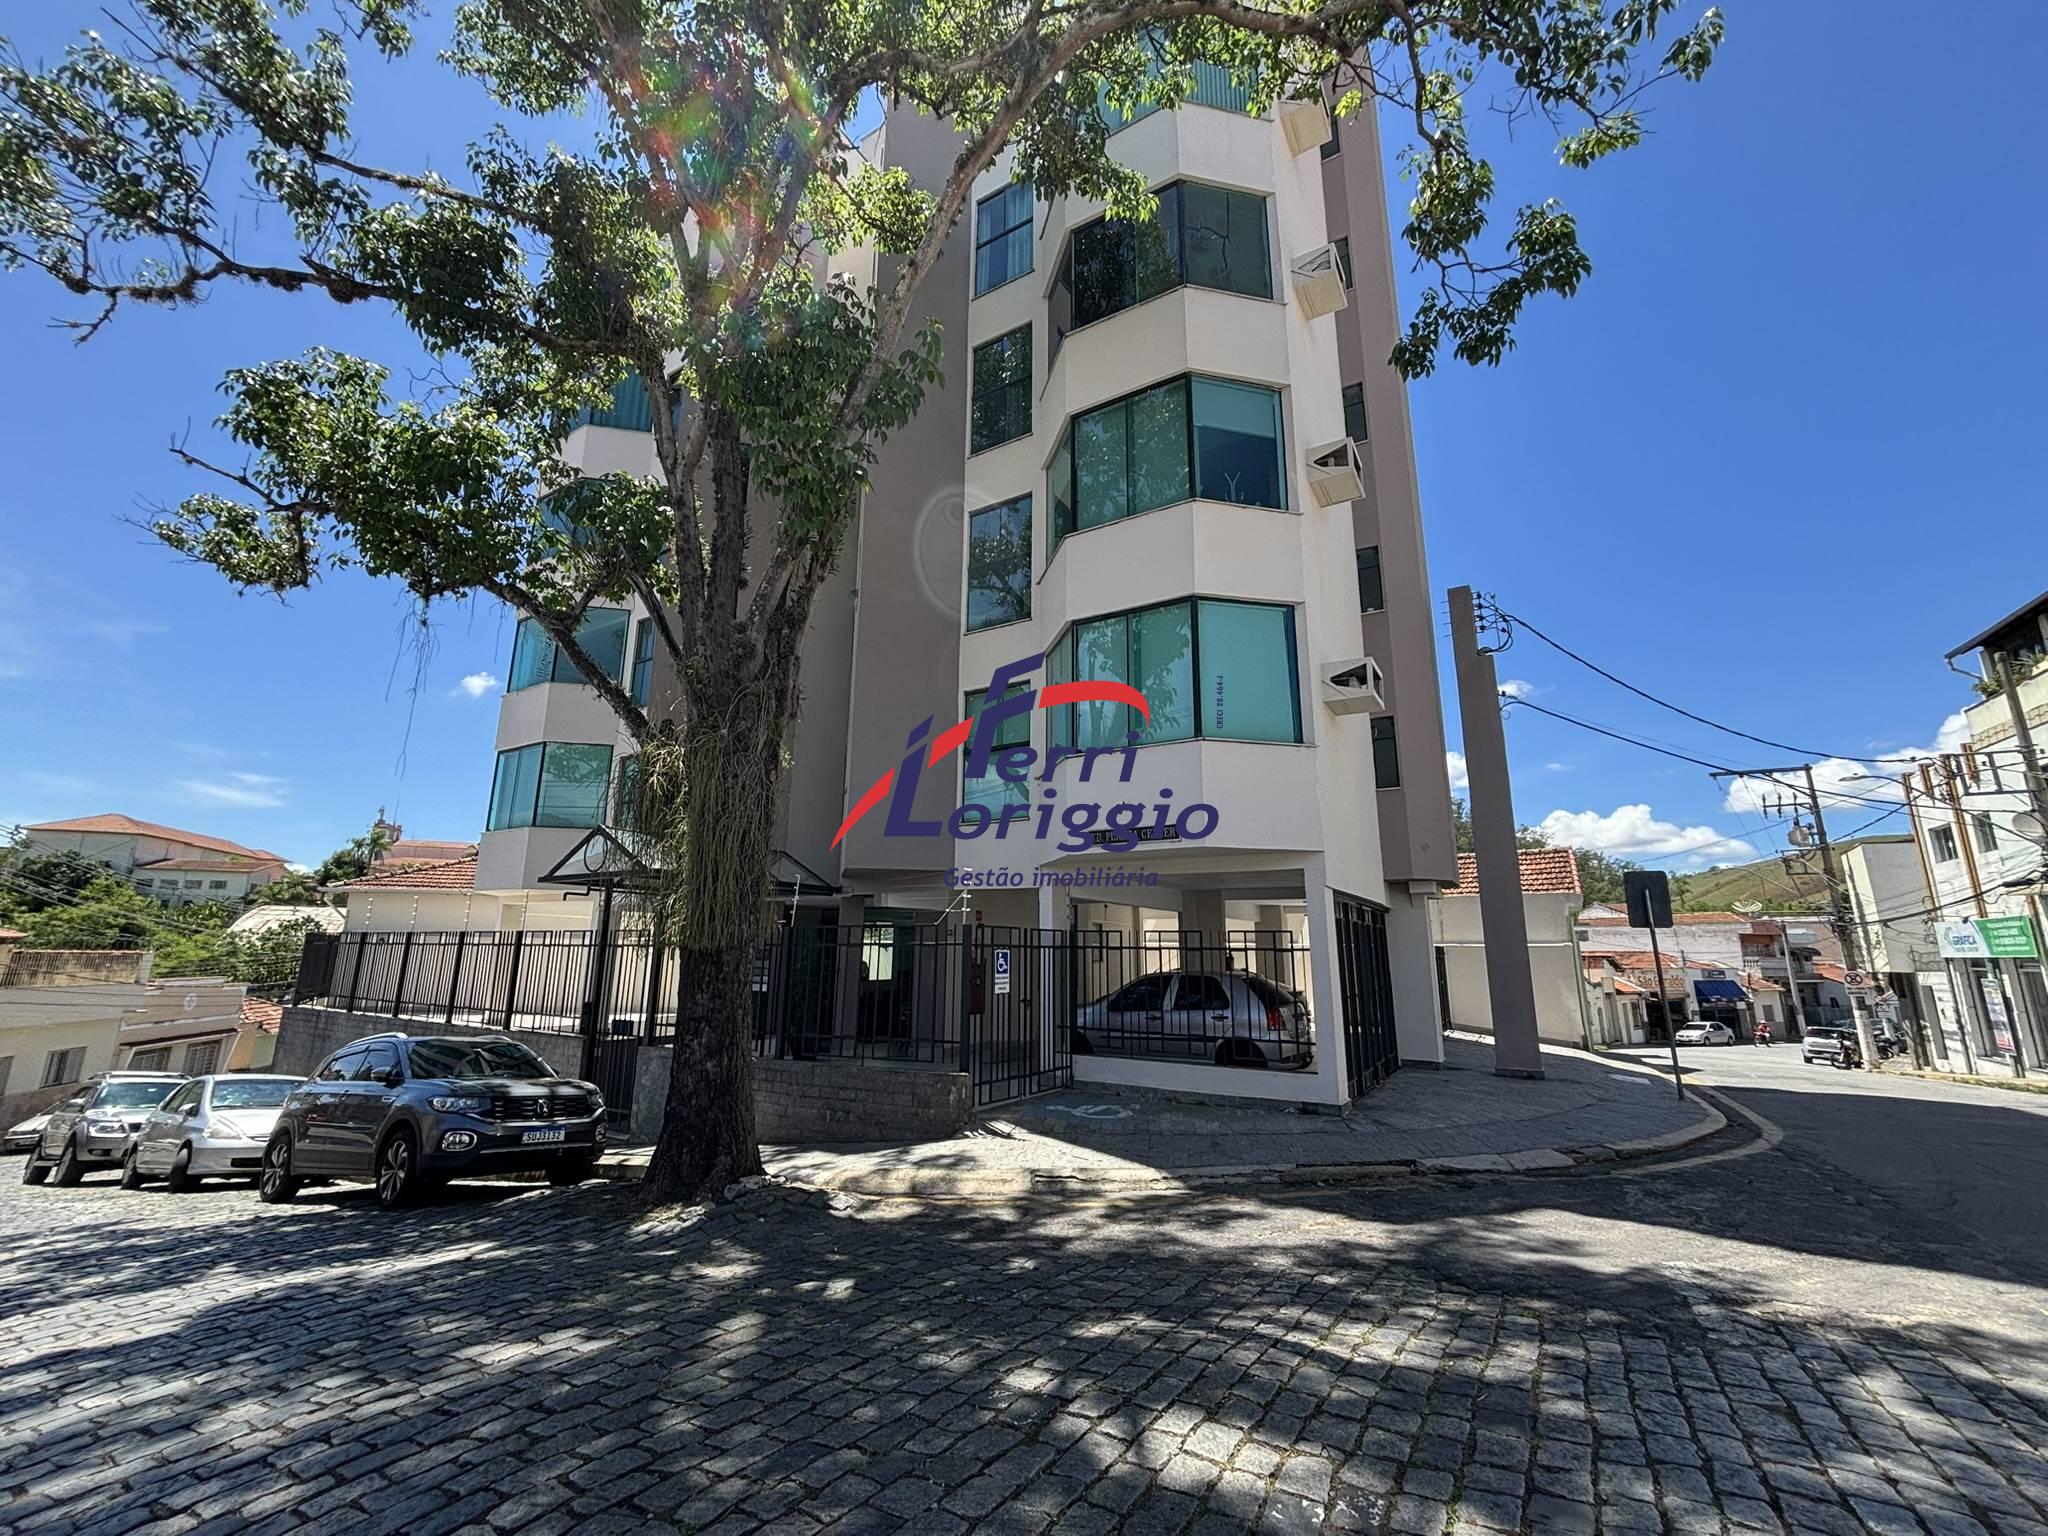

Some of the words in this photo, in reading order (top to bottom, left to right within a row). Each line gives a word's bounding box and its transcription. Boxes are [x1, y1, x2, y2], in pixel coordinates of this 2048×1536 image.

[1216, 675, 1224, 707] 28.464-J
[1216, 709, 1224, 729] CRECI
[1140, 827, 1176, 840] CEER
